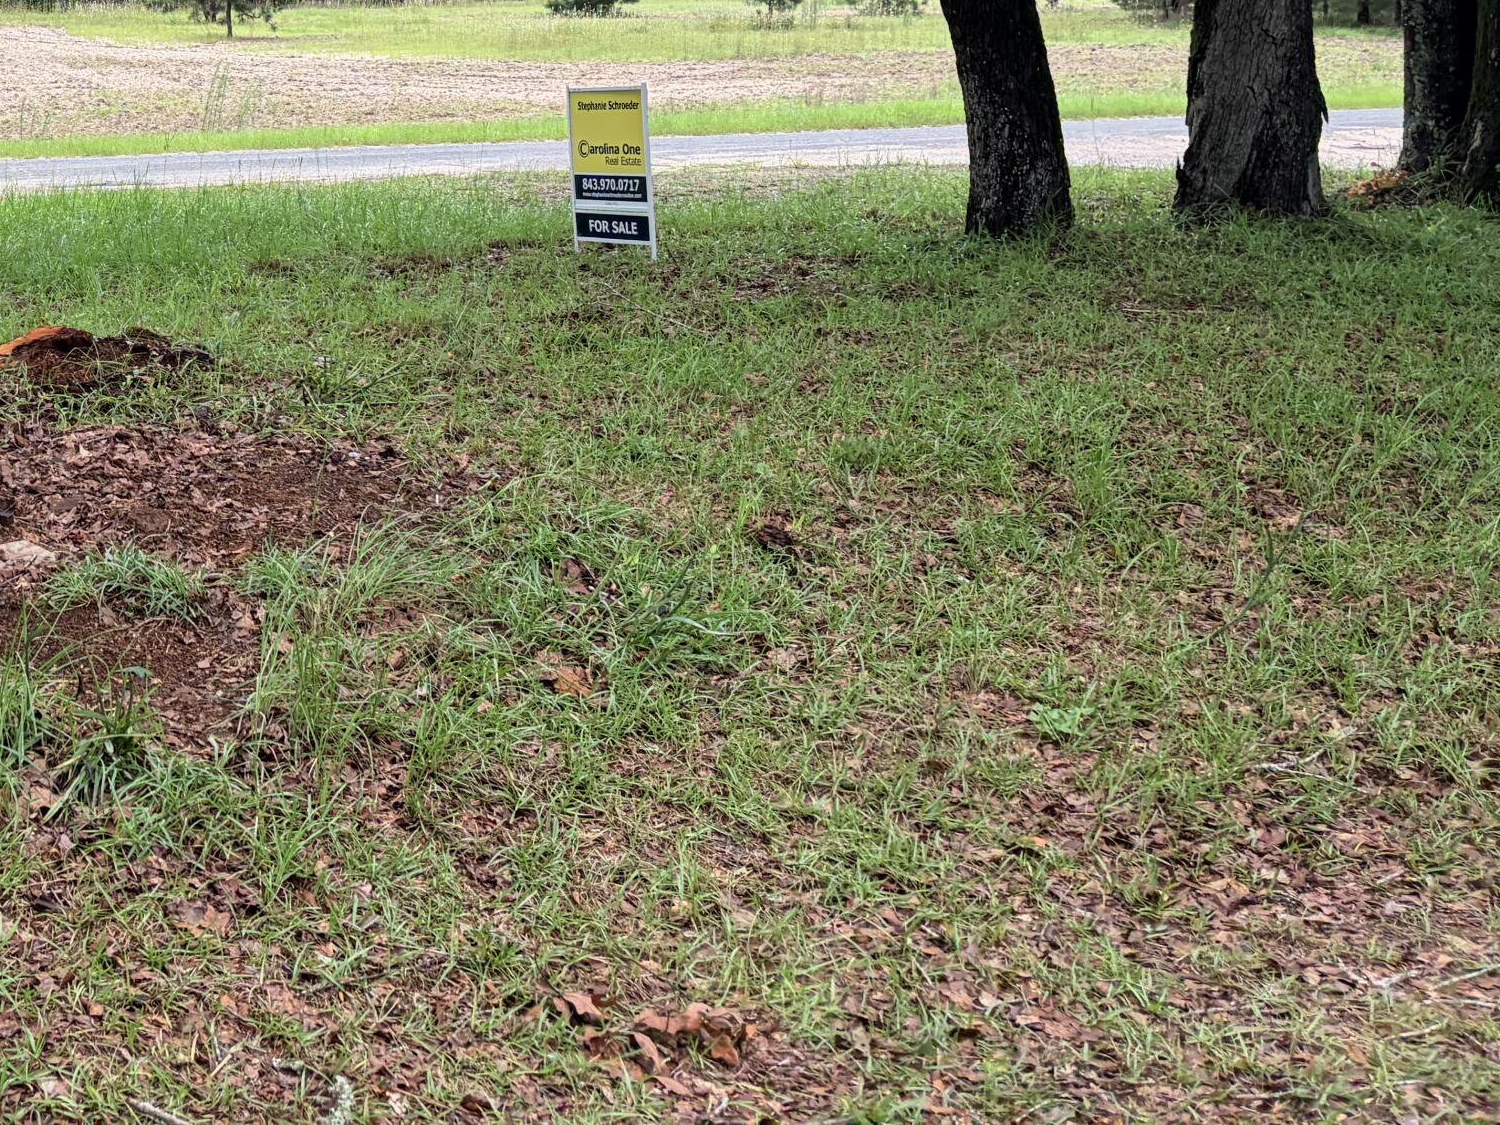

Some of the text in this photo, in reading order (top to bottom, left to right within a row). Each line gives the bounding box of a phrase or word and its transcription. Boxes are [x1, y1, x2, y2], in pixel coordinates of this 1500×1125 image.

[577, 100, 640, 112] Stephanie Schroeder
[578, 140, 641, 158] Carolina One
[605, 156, 642, 166] Real Estate
[582, 178, 640, 192] 843.970.0717
[588, 219, 638, 235] FOR SALE
